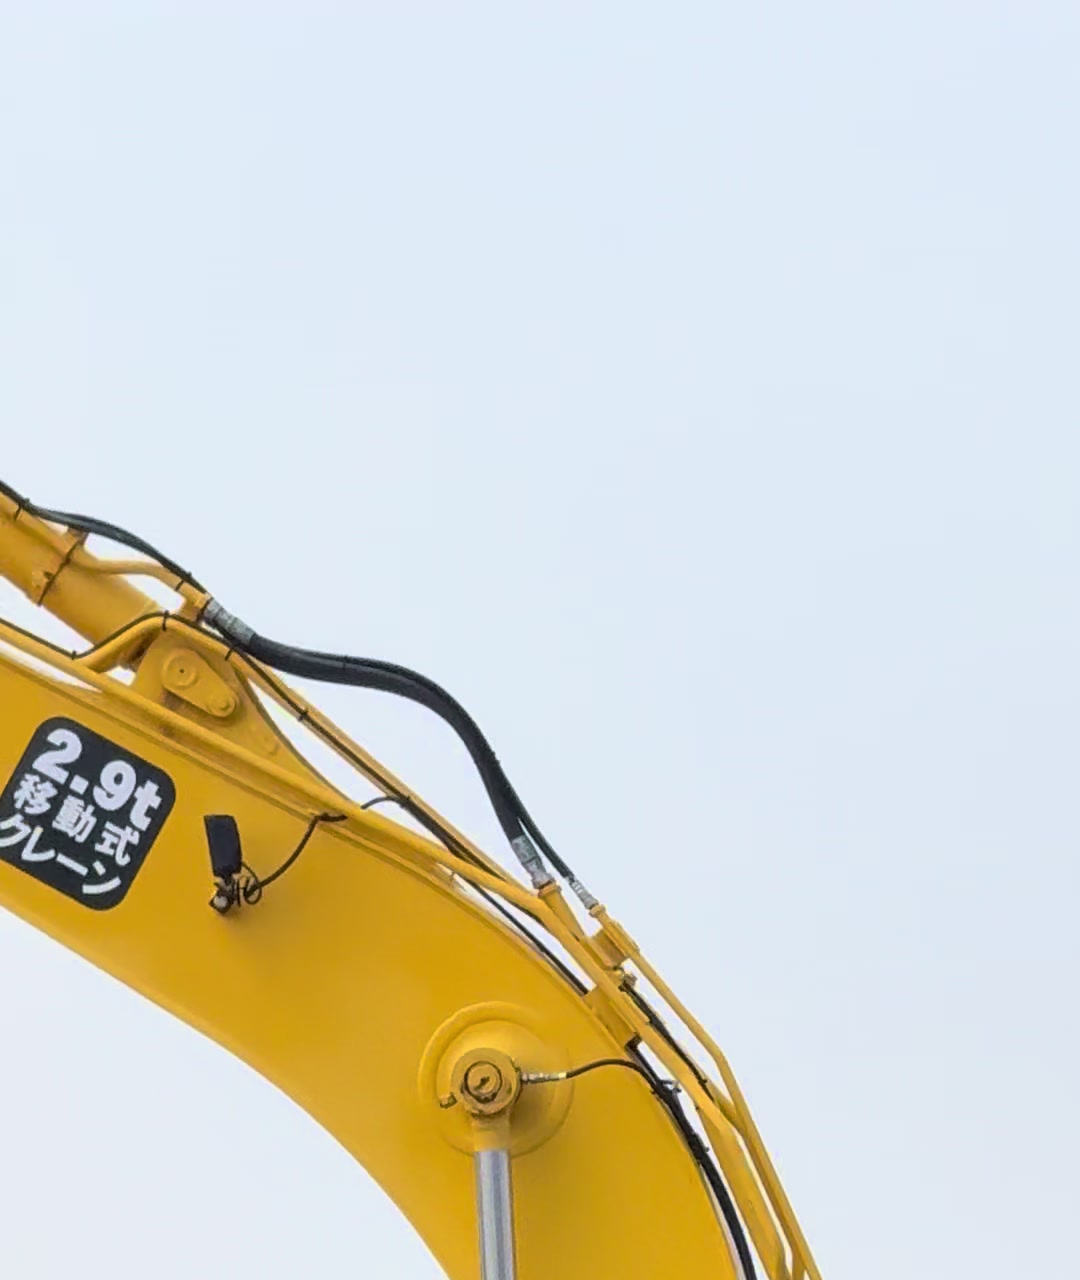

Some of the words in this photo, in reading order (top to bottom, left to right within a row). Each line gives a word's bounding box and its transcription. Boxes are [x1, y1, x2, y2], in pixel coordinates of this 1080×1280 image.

[13, 773, 140, 866] 移動式
[32, 728, 162, 831] 2.9t
